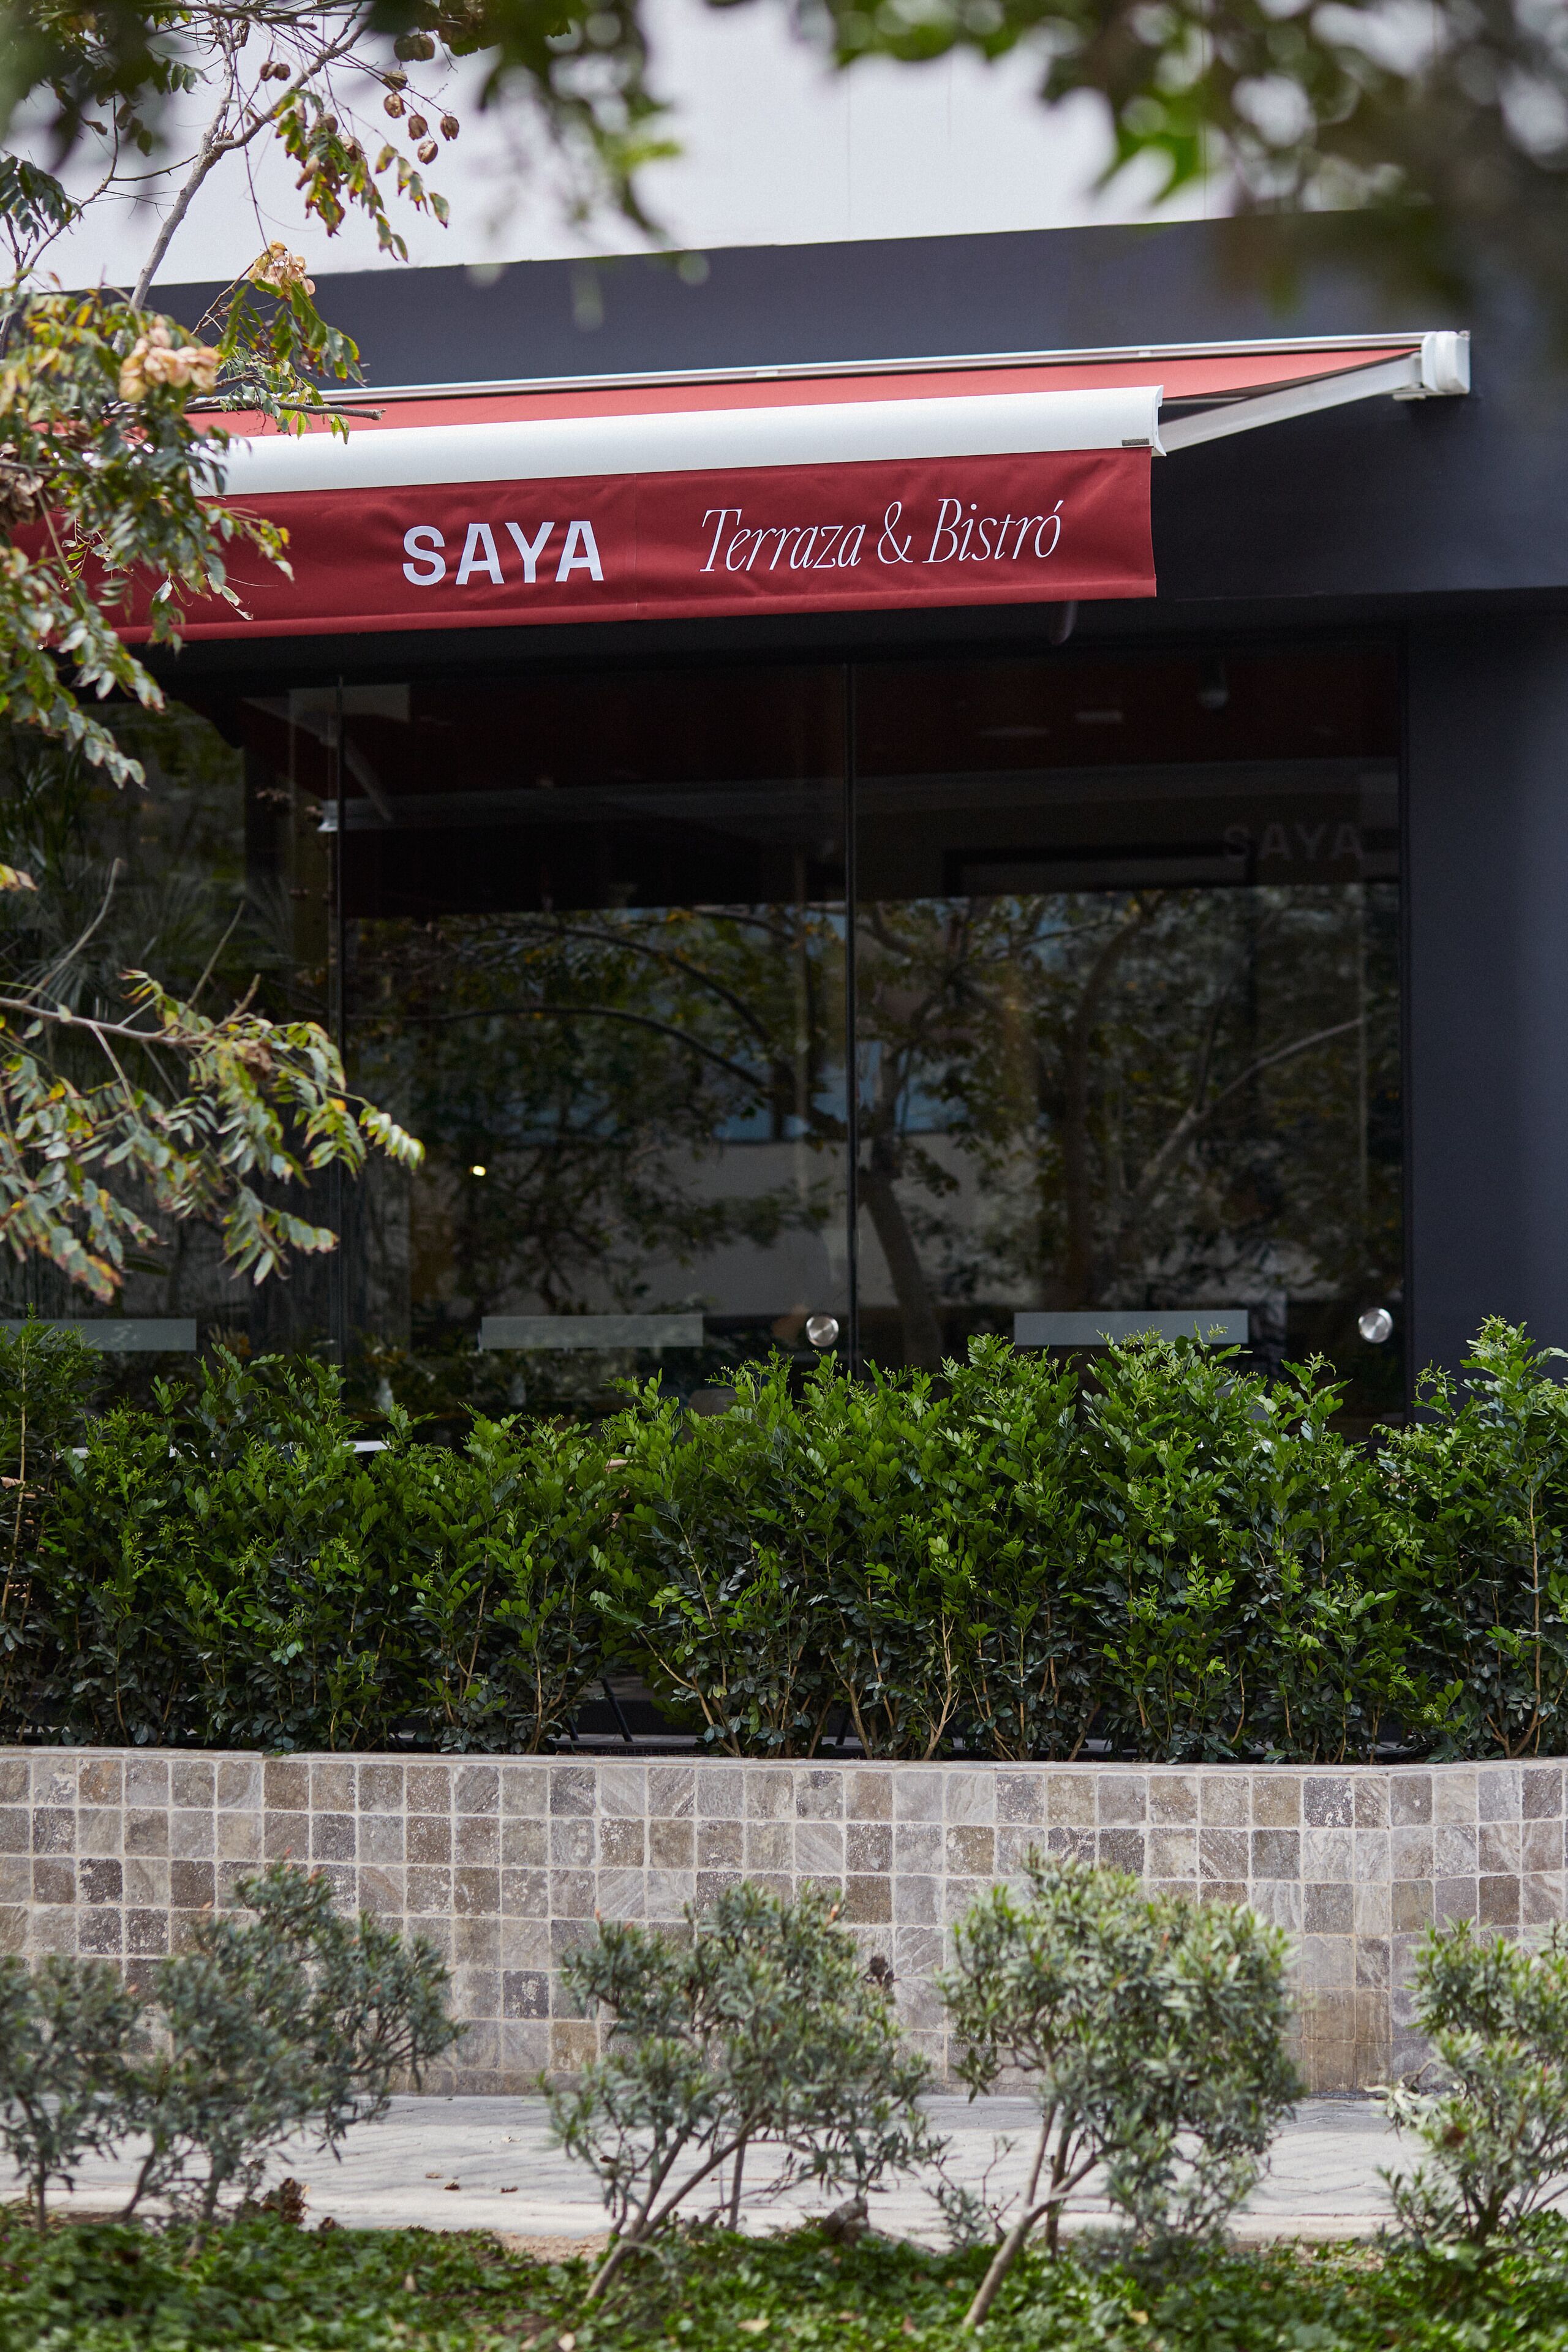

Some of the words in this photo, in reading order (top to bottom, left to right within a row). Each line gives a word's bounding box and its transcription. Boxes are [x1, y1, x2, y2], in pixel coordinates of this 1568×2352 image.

[402, 521, 605, 586] SAYA
[700, 508, 866, 572] Terraza
[877, 501, 913, 564] &
[922, 499, 1064, 564] Bistró
[1223, 824, 1363, 862] SAYA
